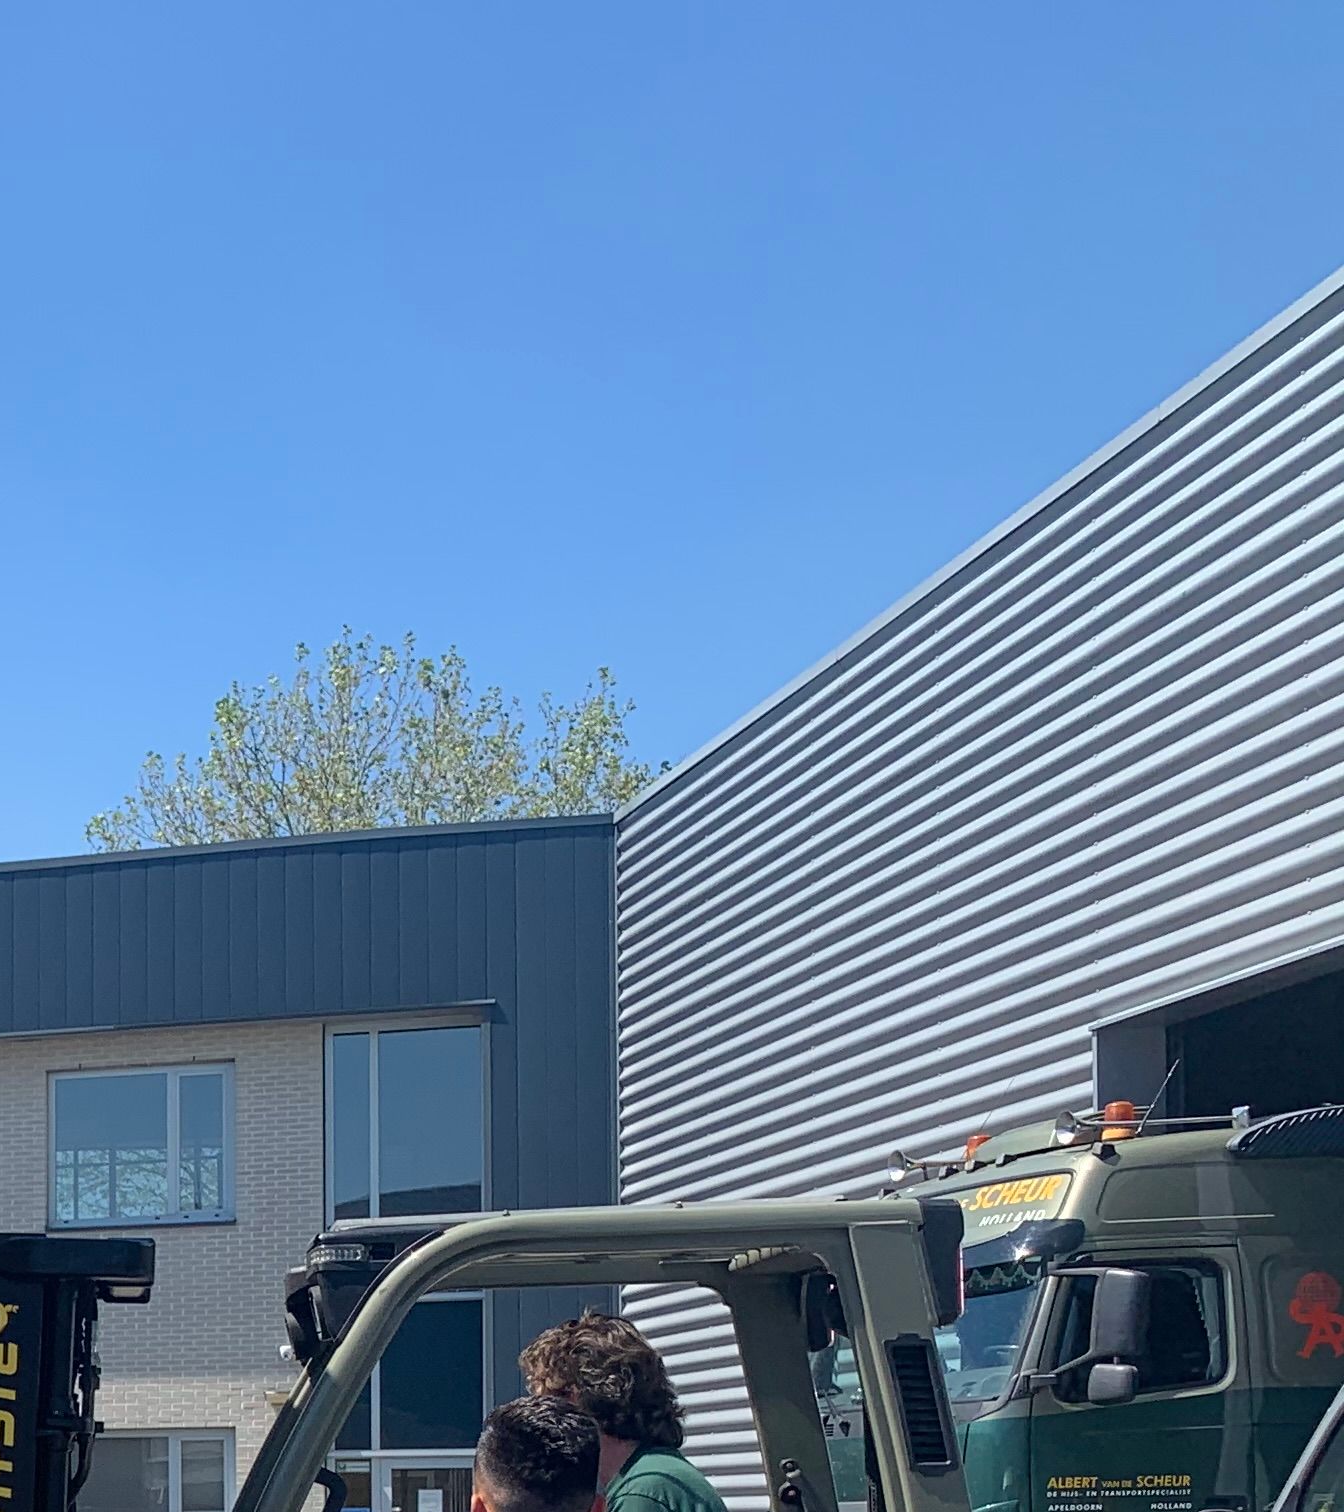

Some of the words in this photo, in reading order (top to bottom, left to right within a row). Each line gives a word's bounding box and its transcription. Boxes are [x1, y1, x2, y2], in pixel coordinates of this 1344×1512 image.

[969, 1175, 1063, 1211] SCHEUR
[1047, 1476, 1098, 1489] ALBERT
[1136, 1475, 1191, 1487] SCHEUR
[1150, 1502, 1192, 1510] HOLLAND
